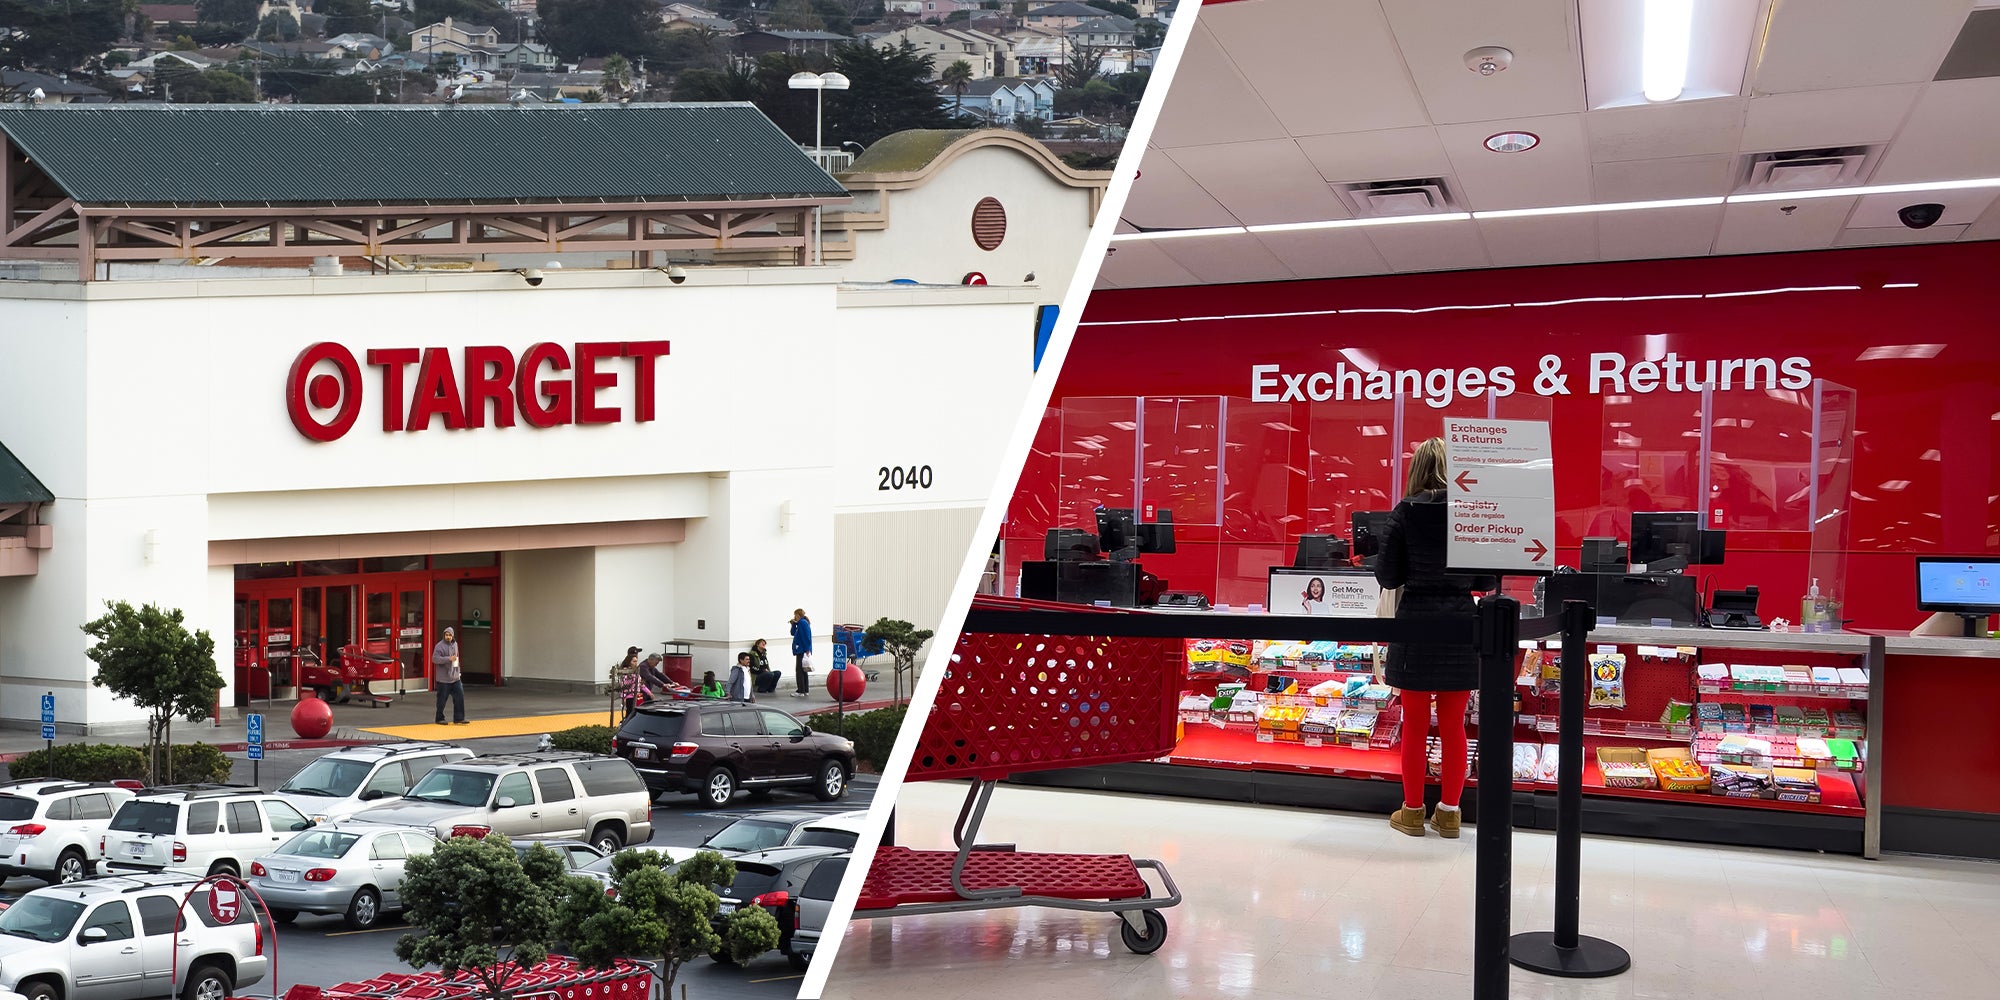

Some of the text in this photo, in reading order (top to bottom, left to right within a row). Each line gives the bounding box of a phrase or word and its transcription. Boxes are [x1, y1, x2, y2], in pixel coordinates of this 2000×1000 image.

[367, 340, 670, 431] TARGET
[1251, 351, 1813, 409] Exchanges & Returns
[1451, 423, 1507, 435] Exchanges
[1451, 434, 1503, 445] & Returns
[878, 465, 933, 490] 2040
[1454, 499, 1499, 511] Registry
[1454, 523, 1524, 536] Order Pickup
[1454, 535, 1480, 543] Entrega
[1345, 586, 1364, 594] More
[1219, 689, 1236, 698] Extra
[1780, 793, 1808, 801] SNICKERS
